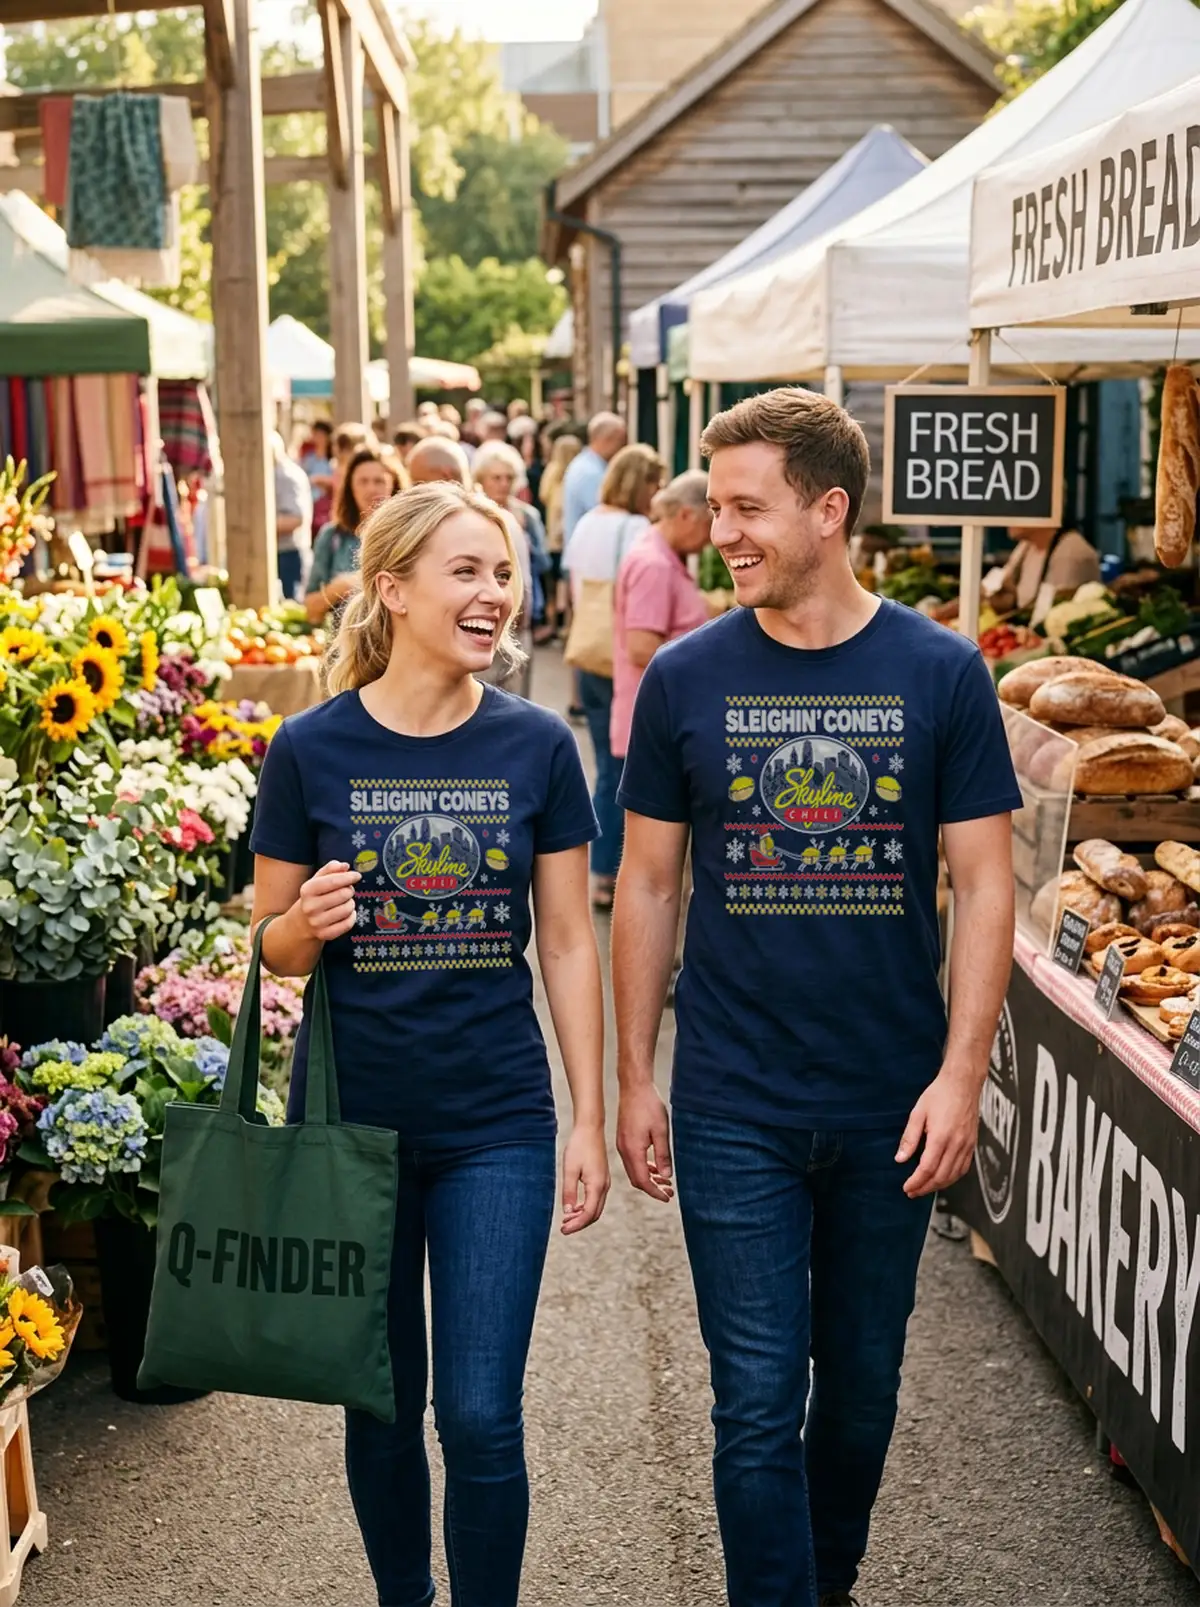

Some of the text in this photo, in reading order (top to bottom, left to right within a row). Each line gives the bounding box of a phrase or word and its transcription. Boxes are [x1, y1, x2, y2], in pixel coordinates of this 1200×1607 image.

[1007, 124, 1200, 288] FRESH BREAD
[909, 411, 1038, 454] FRESH
[905, 459, 1041, 501] BREAD
[725, 708, 904, 733] SLEIGHIN' CONEYS
[350, 790, 509, 812] SLEIGHIN' CONEYS
[774, 768, 857, 810] Skyline
[789, 810, 839, 819] CHILI
[396, 842, 470, 879] Skyline
[409, 879, 454, 888] CHILI
[168, 1222, 366, 1297] Q-FINDER
[1026, 1043, 1200, 1454] BAKERY
